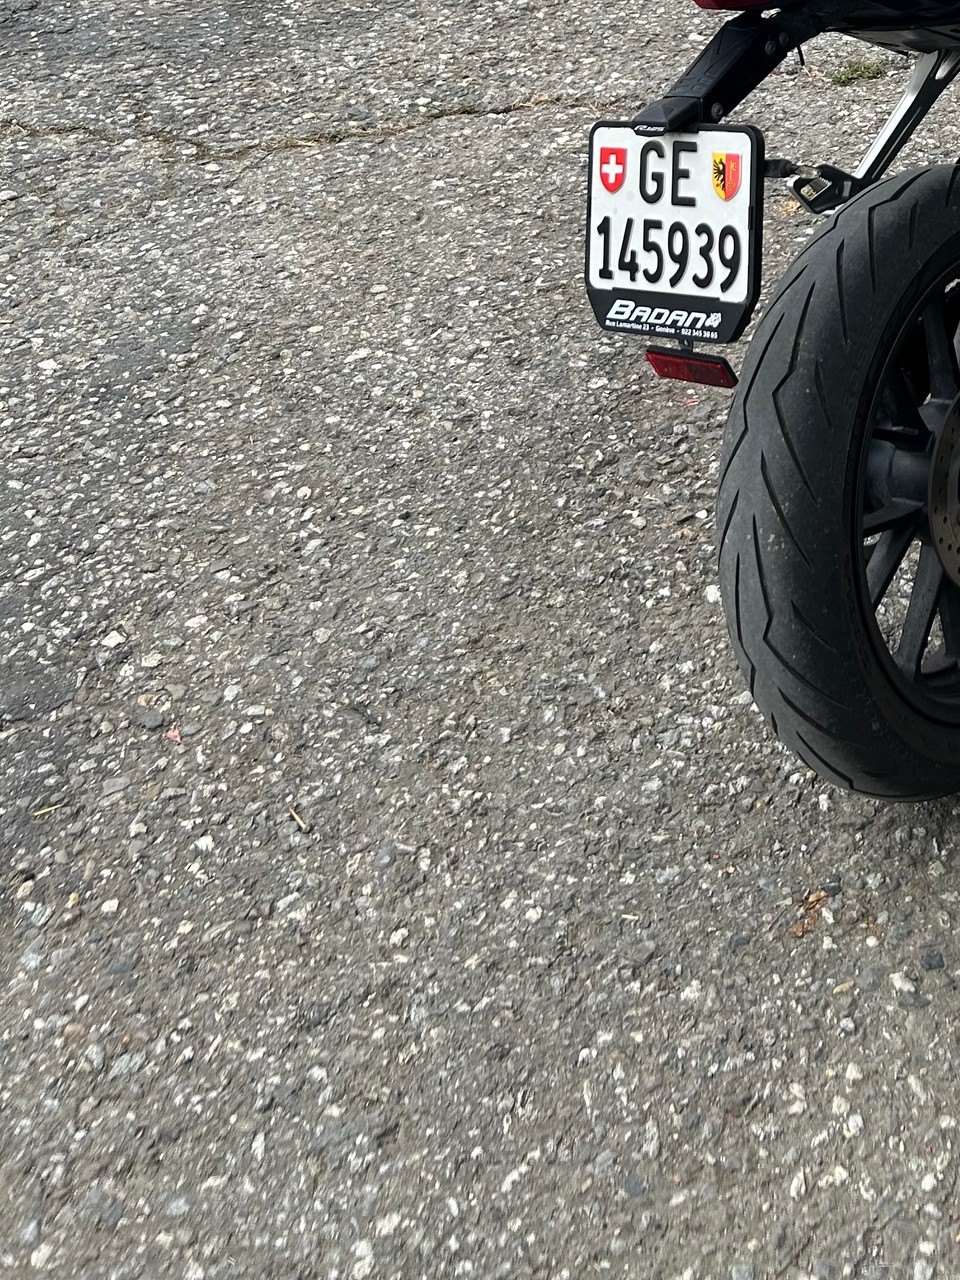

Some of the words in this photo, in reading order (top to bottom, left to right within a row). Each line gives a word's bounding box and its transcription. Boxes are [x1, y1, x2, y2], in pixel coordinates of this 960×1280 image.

[639, 140, 698, 207] GE
[596, 215, 741, 294] 145939
[605, 319, 616, 327] Rue
[616, 320, 642, 331] Lamartine
[642, 323, 650, 331] 23
[655, 325, 675, 334] Genève
[681, 328, 691, 336] 022
[692, 329, 702, 337] 345
